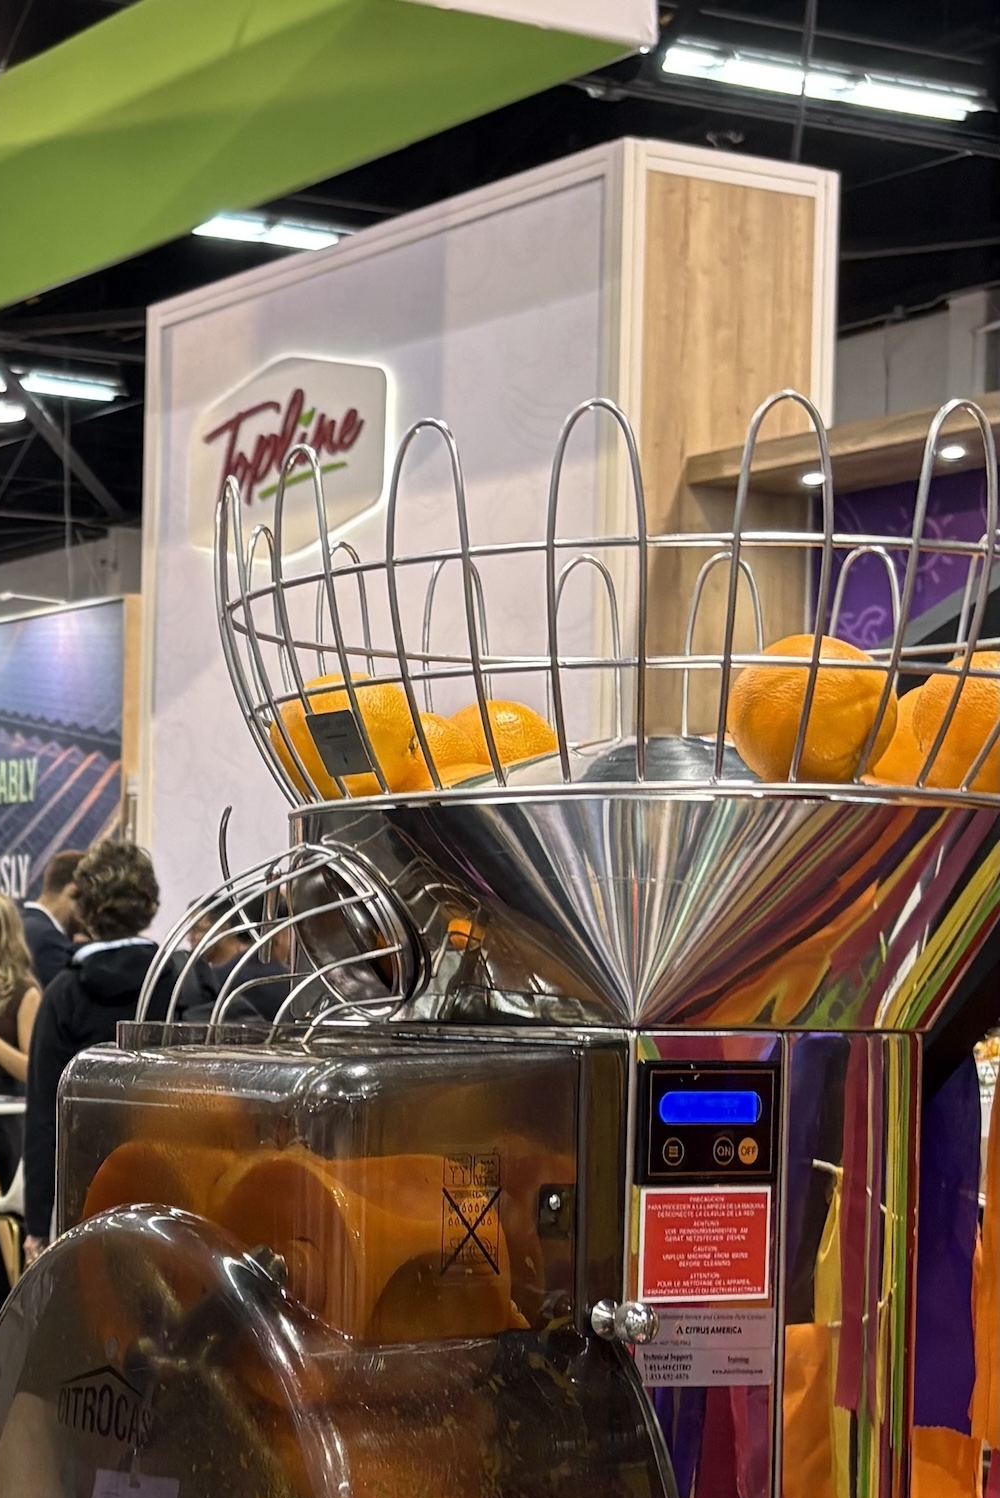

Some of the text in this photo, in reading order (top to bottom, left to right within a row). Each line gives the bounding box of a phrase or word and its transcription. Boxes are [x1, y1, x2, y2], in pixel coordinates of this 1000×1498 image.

[203, 388, 365, 507] Topline
[717, 1145, 756, 1156] ON OFF
[685, 1326, 742, 1334] CITRUS AMERICA
[58, 1384, 151, 1449] CITROCAS
